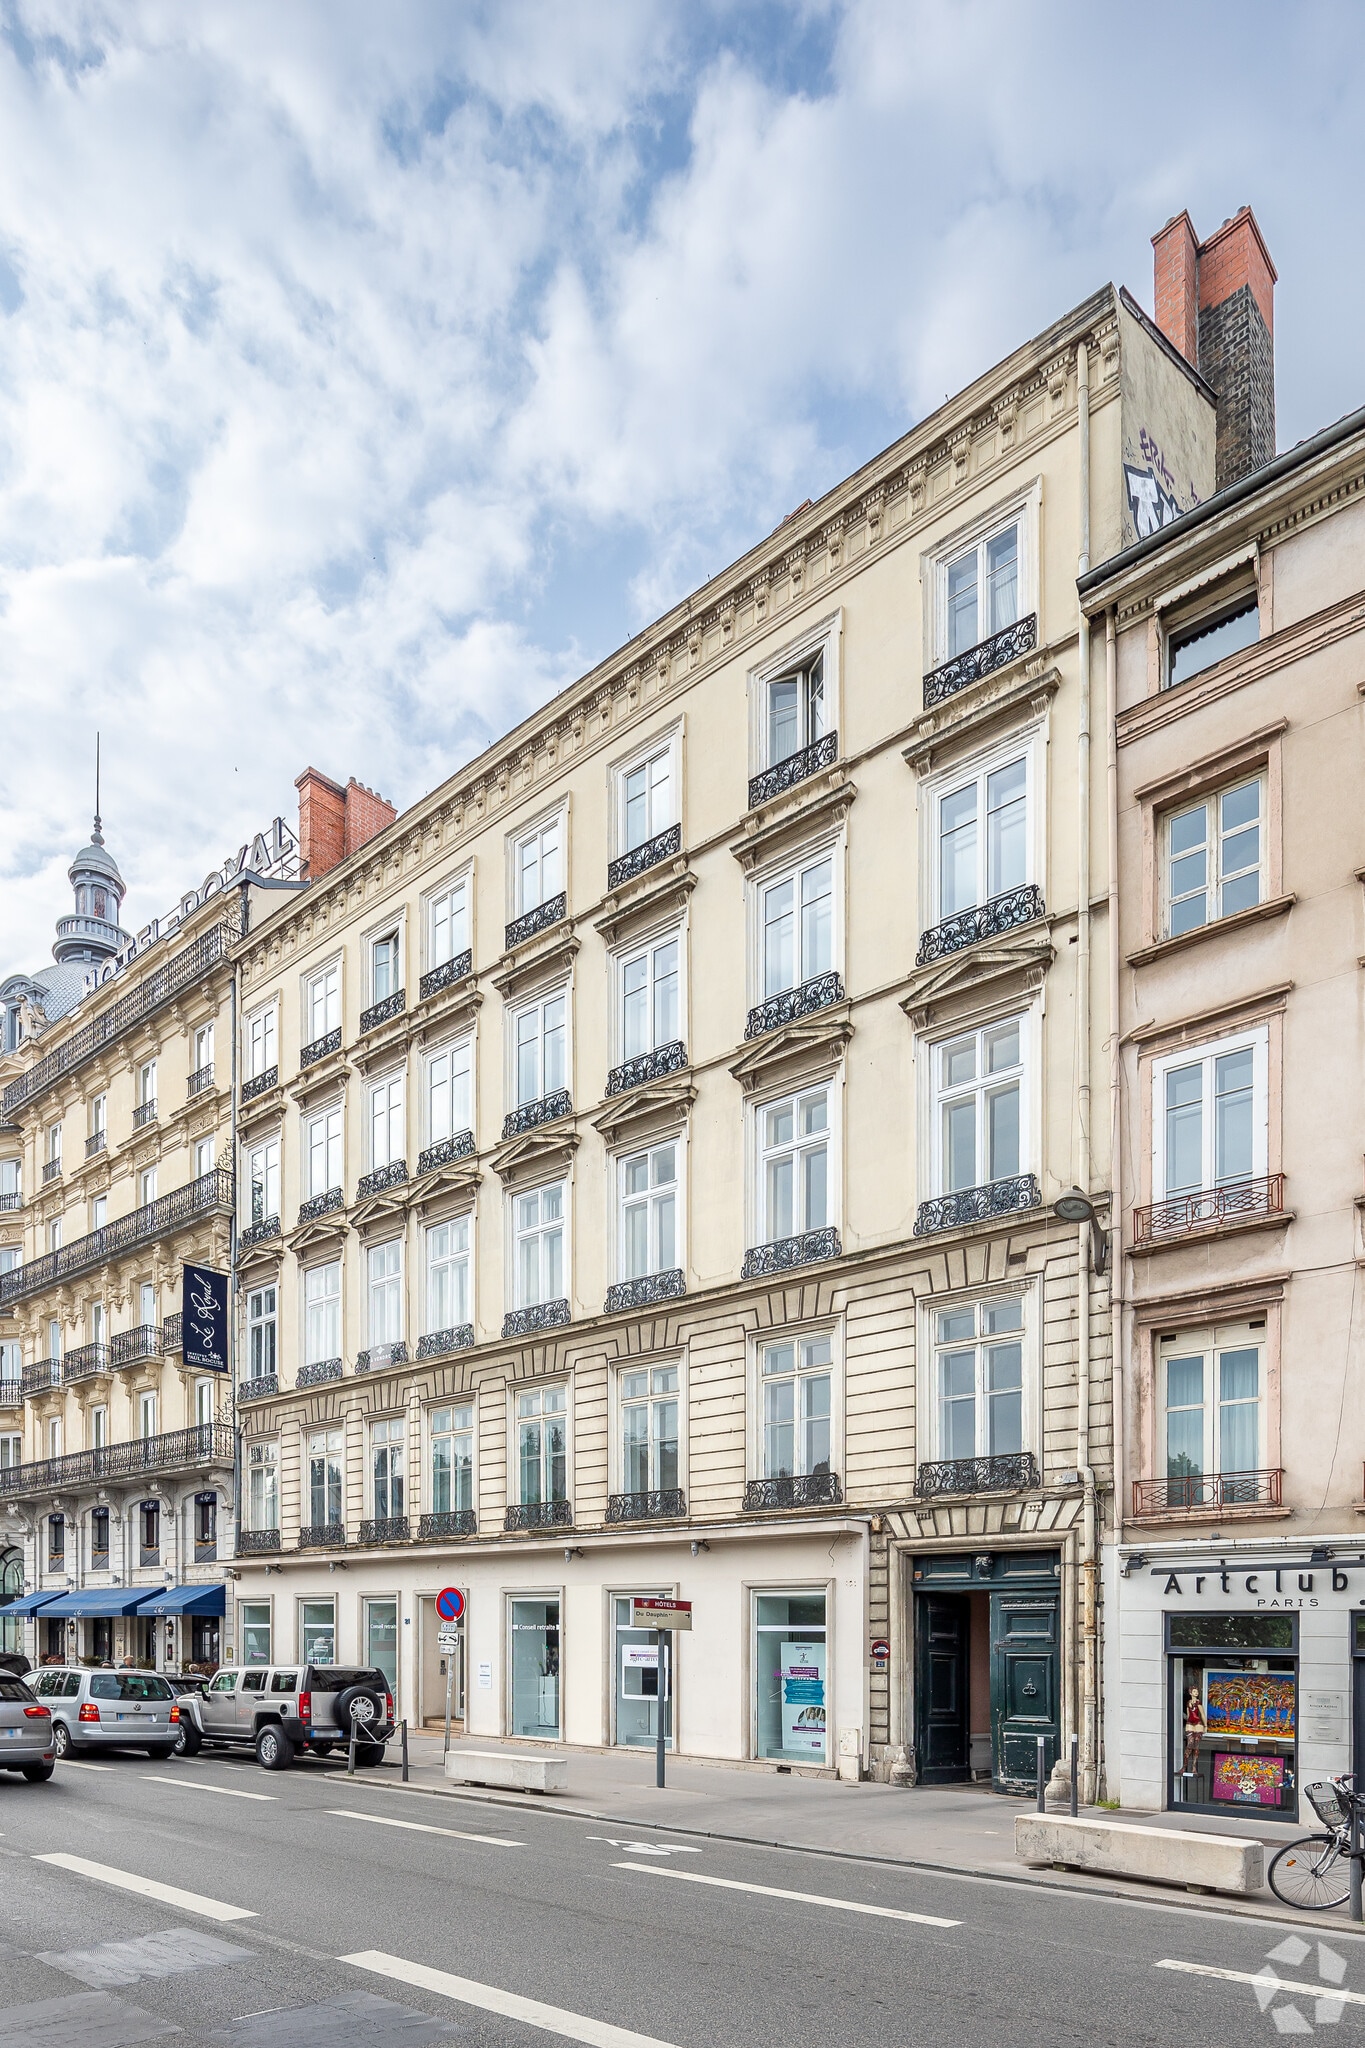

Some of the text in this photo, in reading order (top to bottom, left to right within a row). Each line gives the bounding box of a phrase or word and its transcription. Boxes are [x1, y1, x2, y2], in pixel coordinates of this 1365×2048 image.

[180, 816, 294, 921] ROYAL
[190, 1273, 221, 1349] Le Royal
[187, 1354, 201, 1362] PAUL
[1163, 1567, 1349, 1595] Artclub
[654, 1600, 677, 1608] HÔTELS
[1257, 1598, 1319, 1607] PARIS
